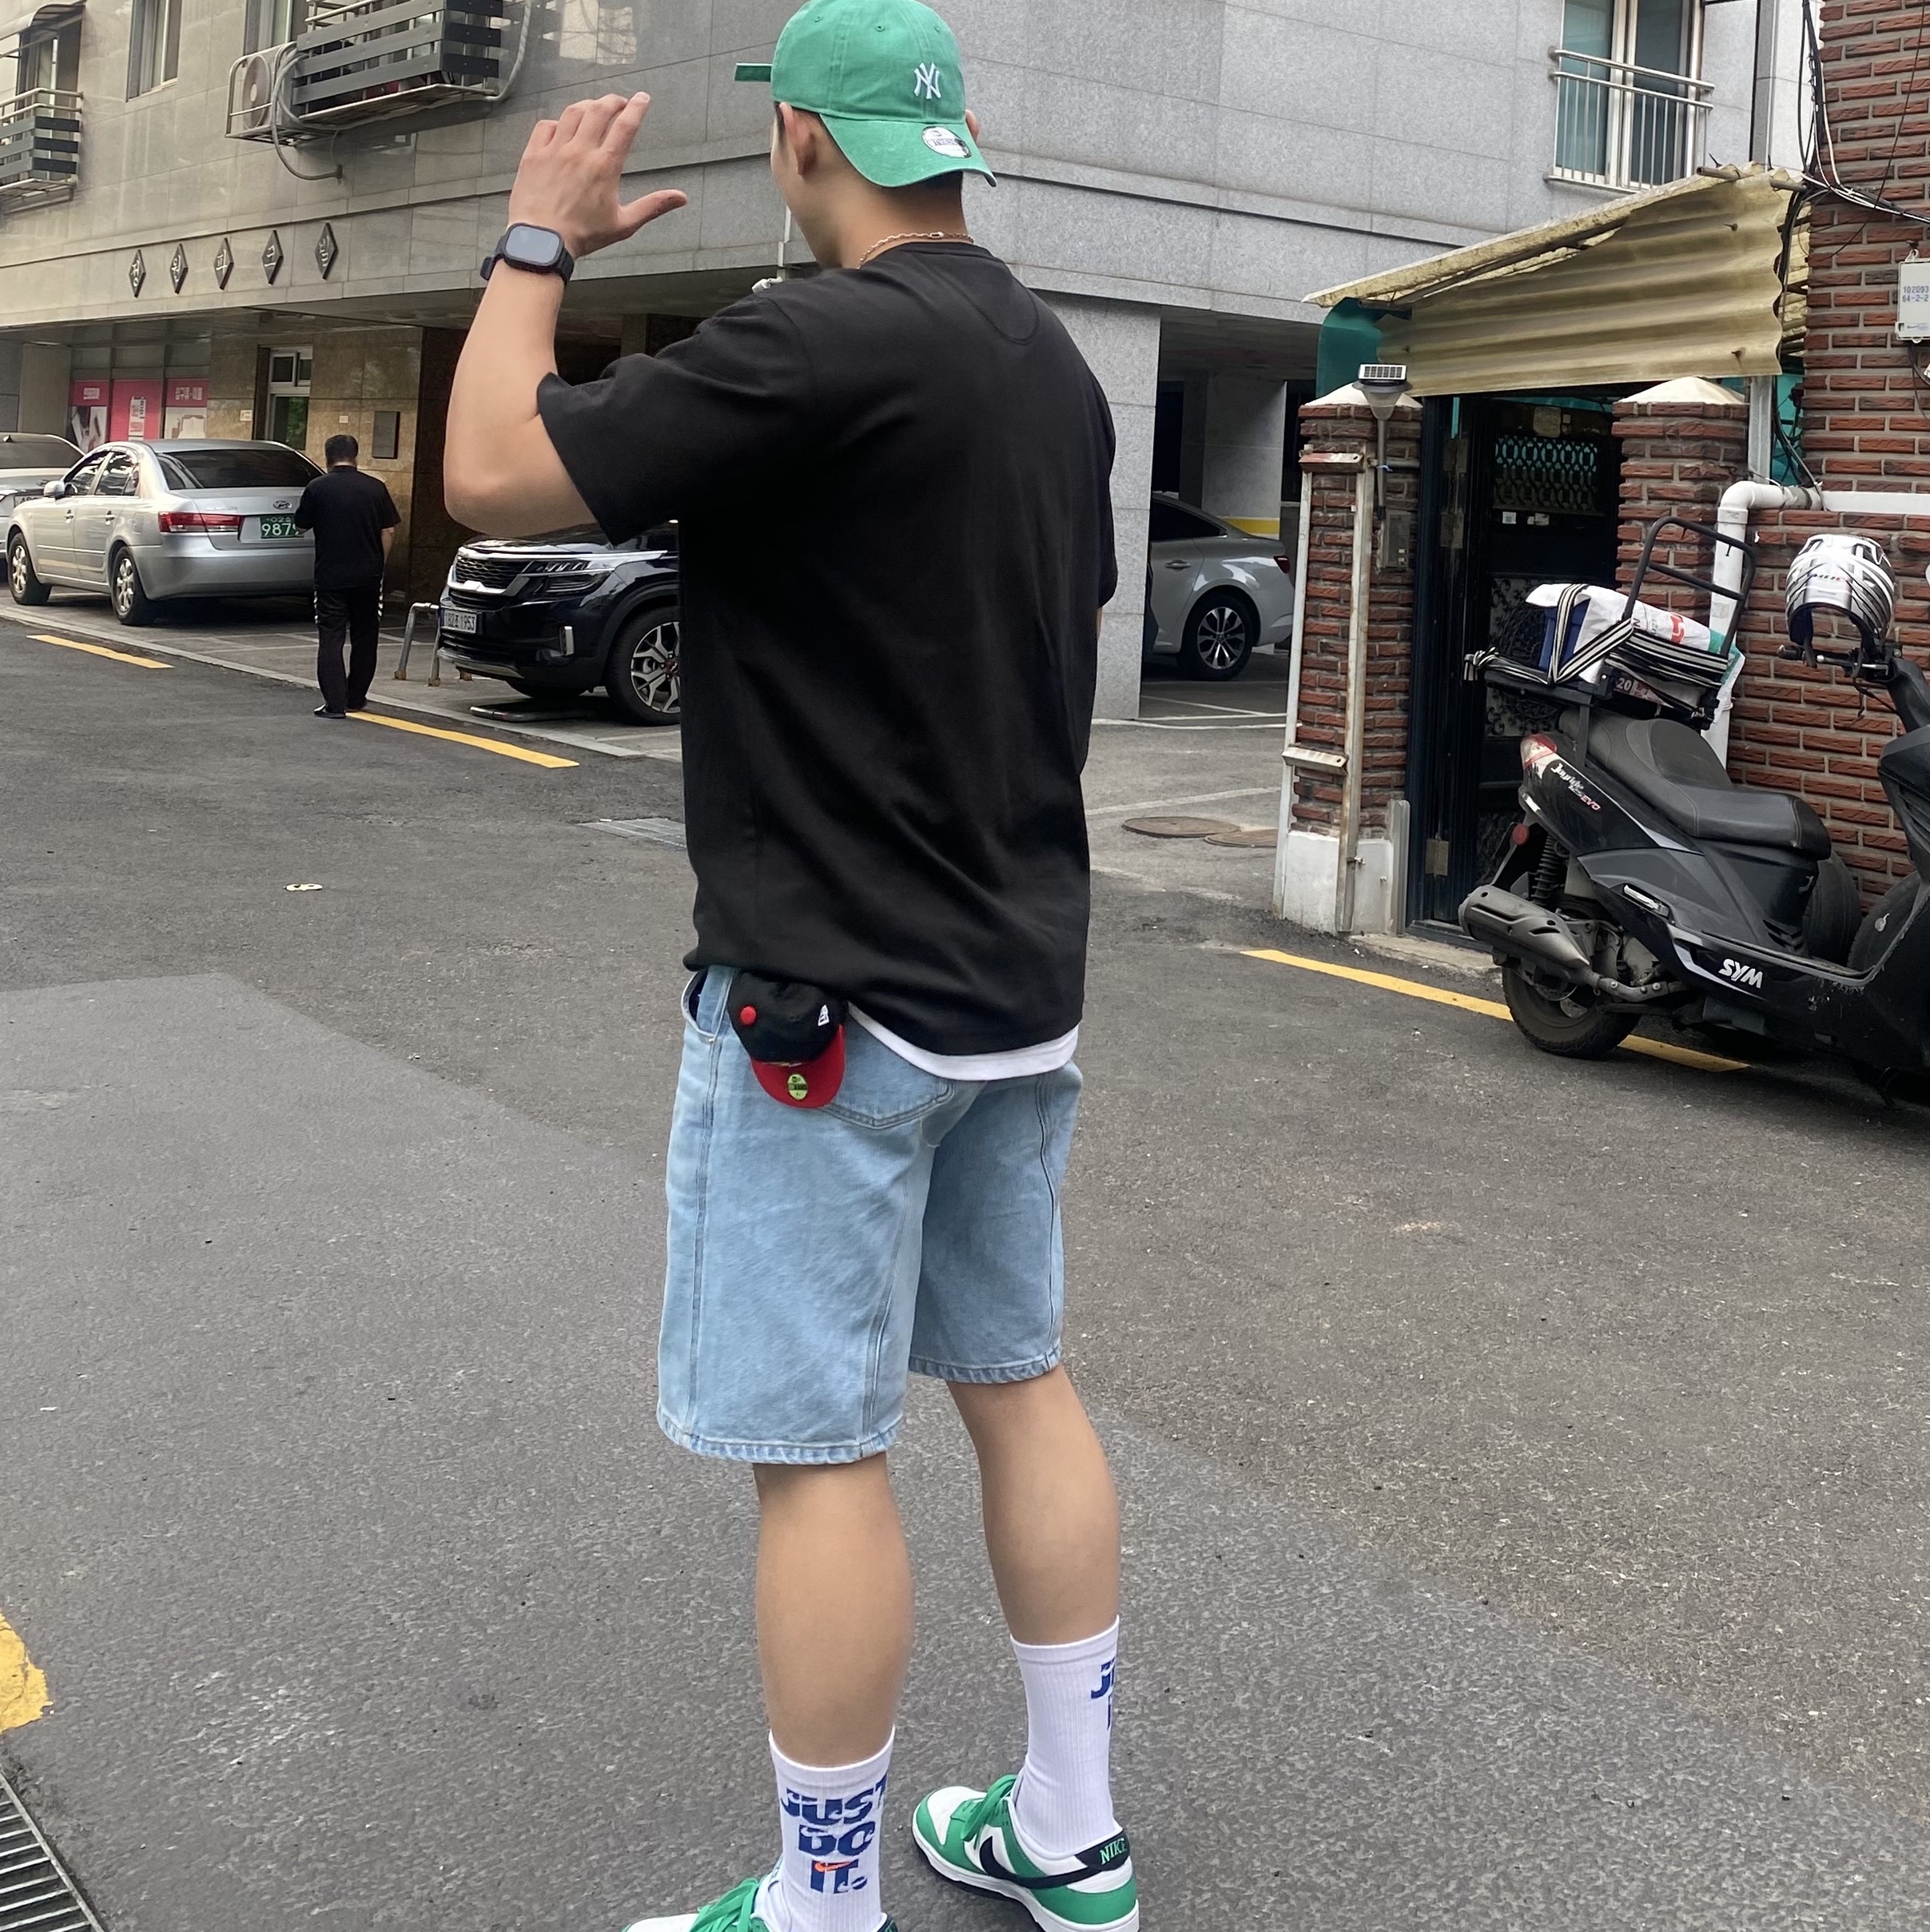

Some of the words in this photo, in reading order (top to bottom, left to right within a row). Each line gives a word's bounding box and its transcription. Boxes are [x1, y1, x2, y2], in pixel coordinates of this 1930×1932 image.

[913, 62, 941, 99] NY
[1718, 958, 1763, 989] SYM
[1100, 1838, 1127, 1866] NIKE
